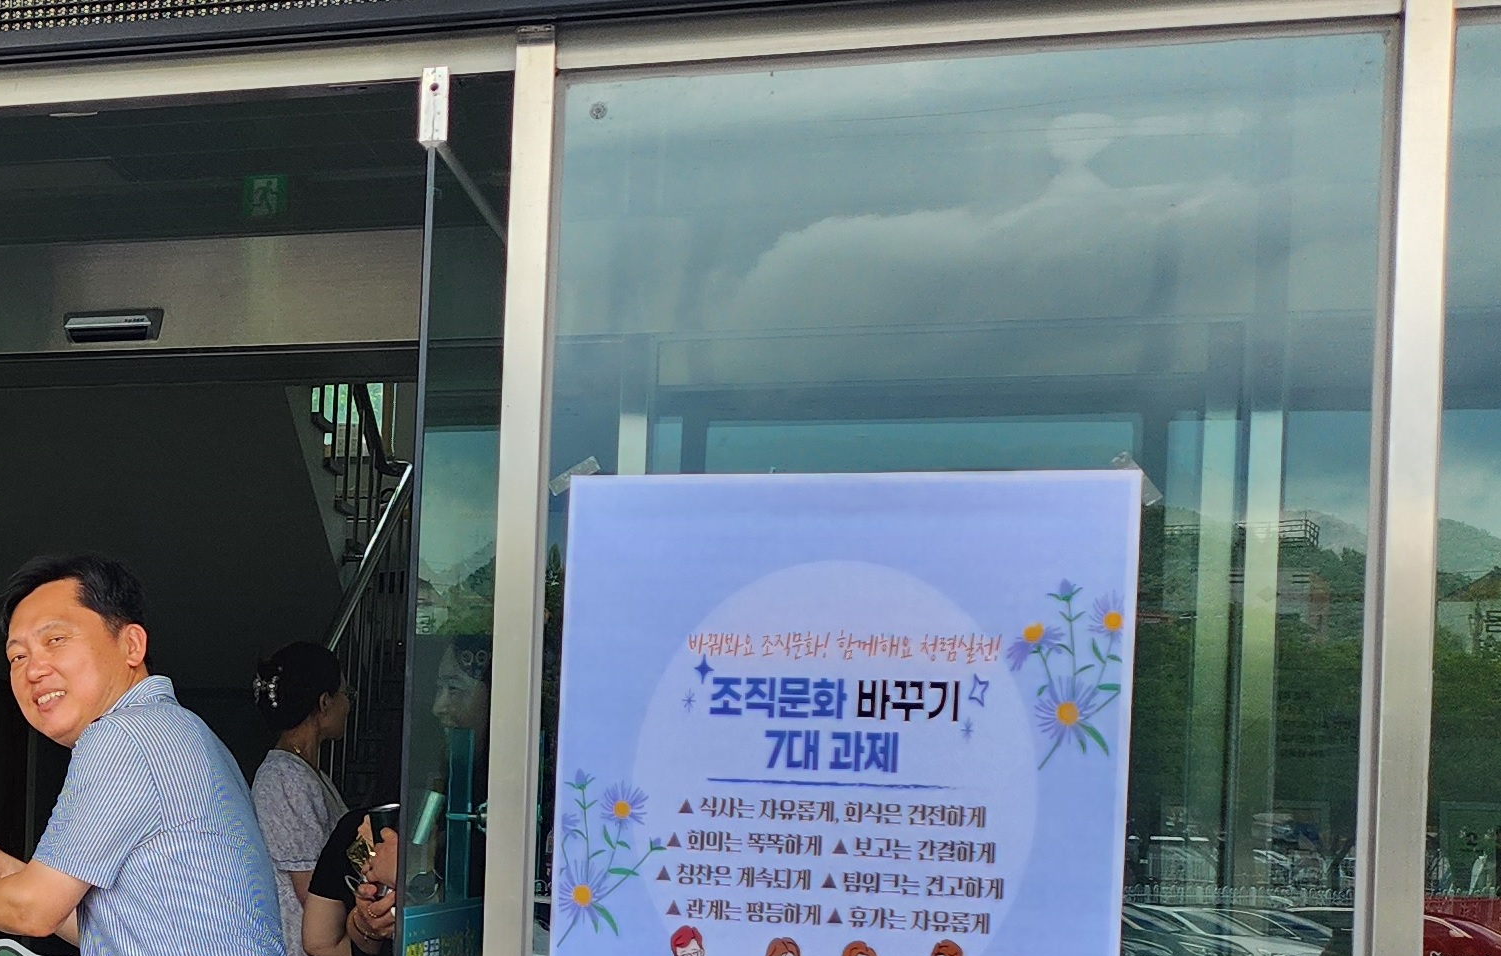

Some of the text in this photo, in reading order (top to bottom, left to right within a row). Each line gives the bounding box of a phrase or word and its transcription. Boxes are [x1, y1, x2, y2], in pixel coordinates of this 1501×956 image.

[688, 629, 1002, 664] 바꿔봐요 조직문화! 함께해요 청렴실천!
[709, 676, 960, 722] 조직문화 바꾸기
[765, 729, 899, 773] 7대 과제
[700, 796, 987, 828] 식사는 자유롭게, 회식은 건전하게
[687, 830, 822, 857] 회의는 똑똑하게
[853, 837, 996, 865] 보고는 간결하게
[676, 863, 812, 891] 칭찬은 계속되게
[842, 870, 1005, 901] 팀워크는 견고하게
[686, 898, 821, 926] 관계는 평등하게
[849, 906, 991, 935] 휴가는 자유롭게
